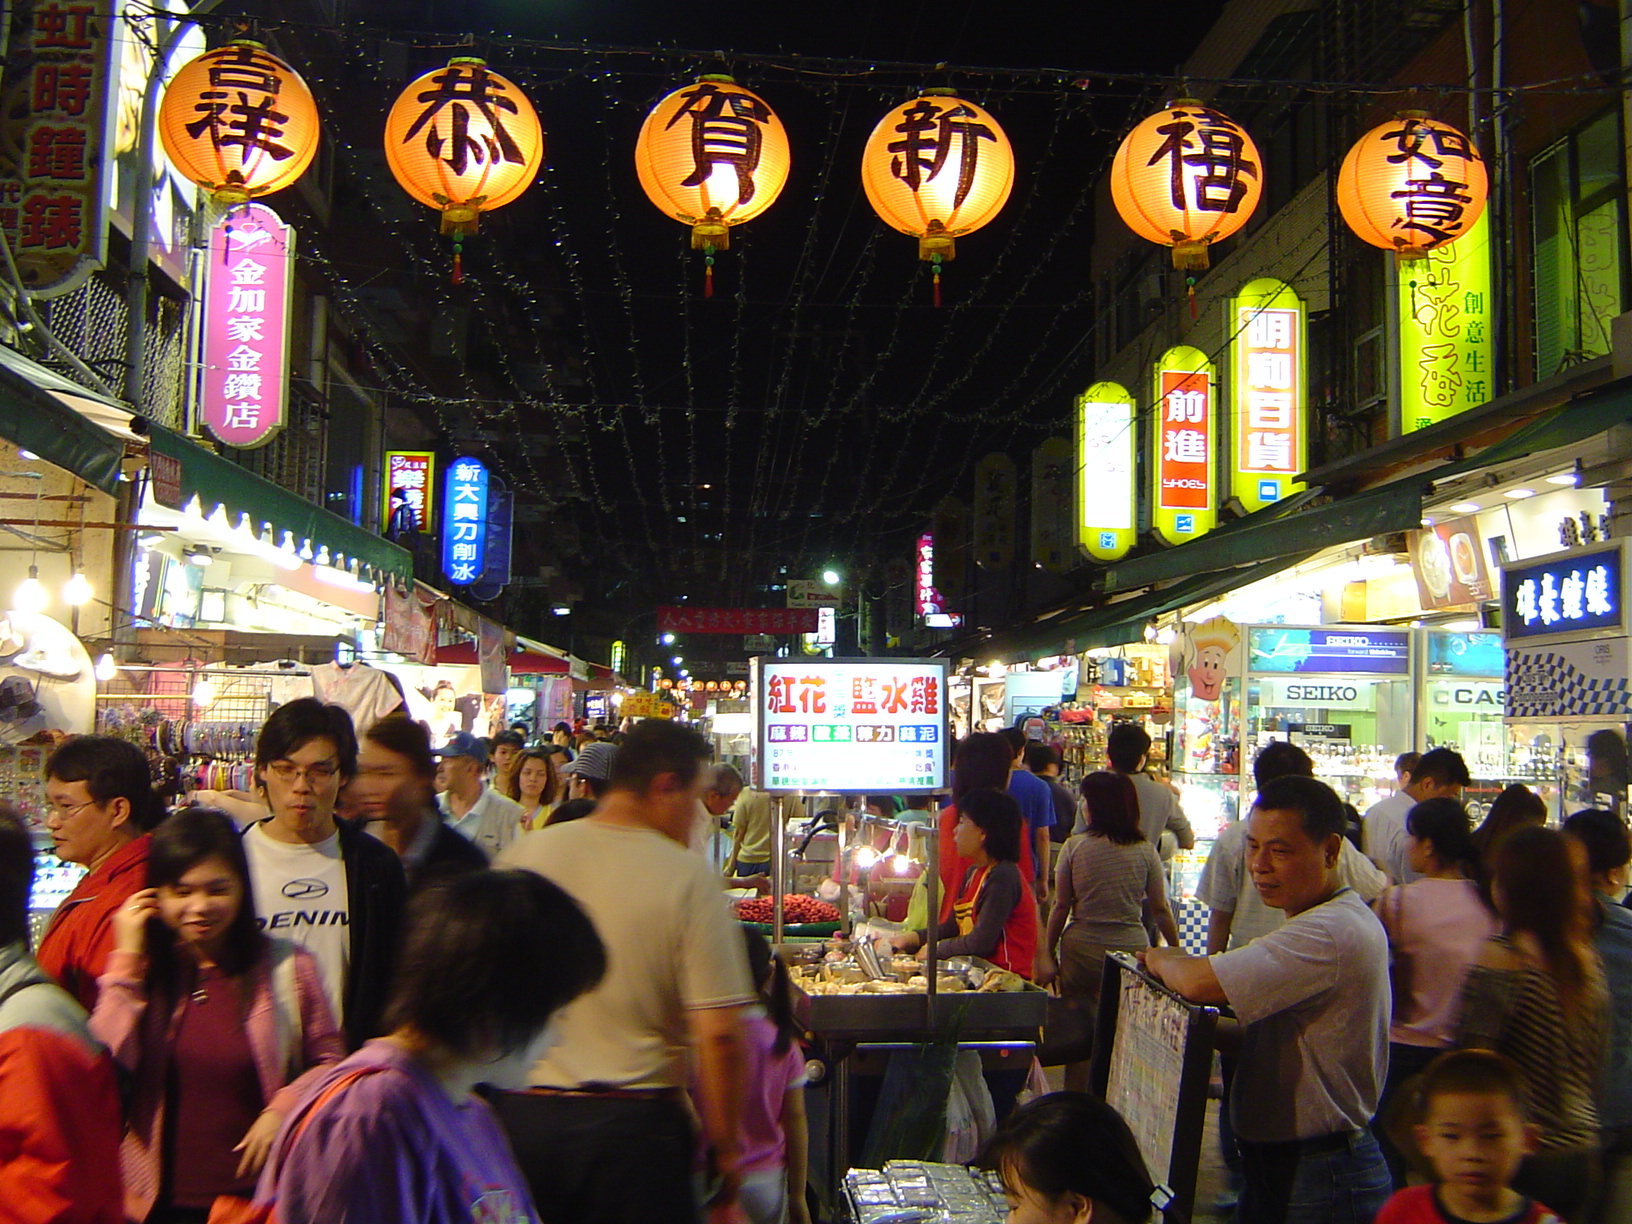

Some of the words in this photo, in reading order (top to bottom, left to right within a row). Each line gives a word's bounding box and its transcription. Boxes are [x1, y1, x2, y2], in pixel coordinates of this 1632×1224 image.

[185, 48, 295, 166] 吉祥
[402, 66, 526, 176] 恭
[664, 84, 772, 206] 賀
[887, 100, 998, 211] 新
[1146, 110, 1259, 213] 禧
[1380, 120, 1483, 248] 如意
[223, 258, 267, 429] 金加家金鑽店
[1464, 291, 1486, 403] 創意生活
[1164, 390, 1206, 463] 前進
[391, 469, 425, 527] 樂透
[768, 675, 826, 714] 紅花
[1287, 685, 1357, 701] SEIKO
[1326, 636, 1369, 646] SEIKO
